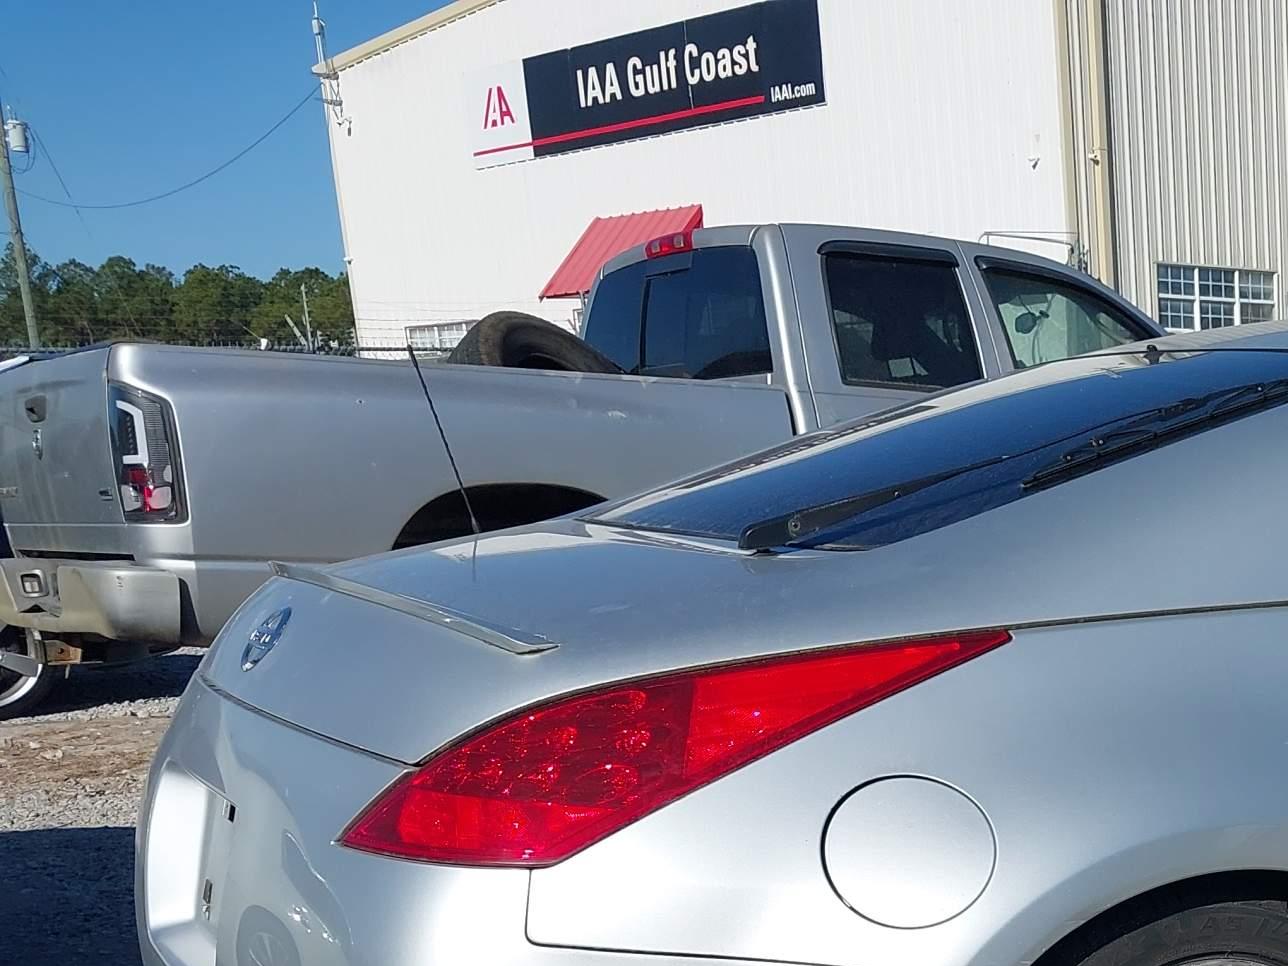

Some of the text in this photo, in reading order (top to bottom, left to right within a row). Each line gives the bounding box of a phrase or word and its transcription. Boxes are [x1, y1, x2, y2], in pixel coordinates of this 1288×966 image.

[575, 35, 760, 108] IAA Gulf Coast
[770, 82, 816, 103] IAAI.com
